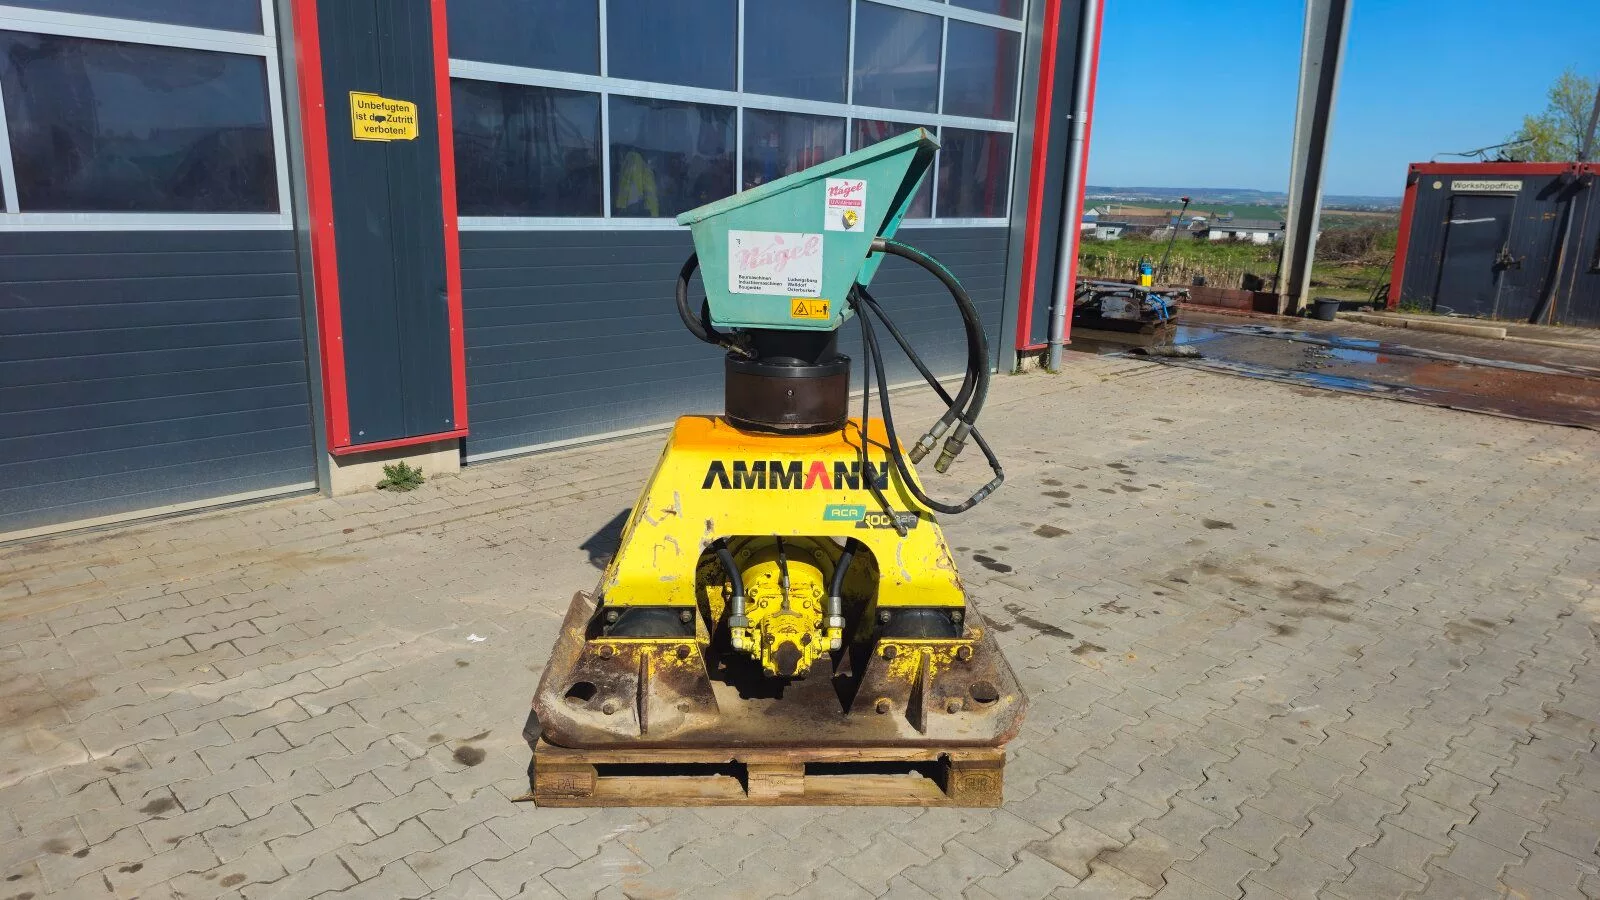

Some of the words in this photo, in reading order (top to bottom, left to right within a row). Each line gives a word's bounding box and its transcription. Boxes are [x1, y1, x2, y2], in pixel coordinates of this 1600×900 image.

[357, 100, 409, 113] Unbefugten
[355, 112, 367, 121] ist
[386, 114, 414, 124] Zutritt
[364, 126, 406, 135] verboten!
[701, 460, 888, 490] AMMANN
